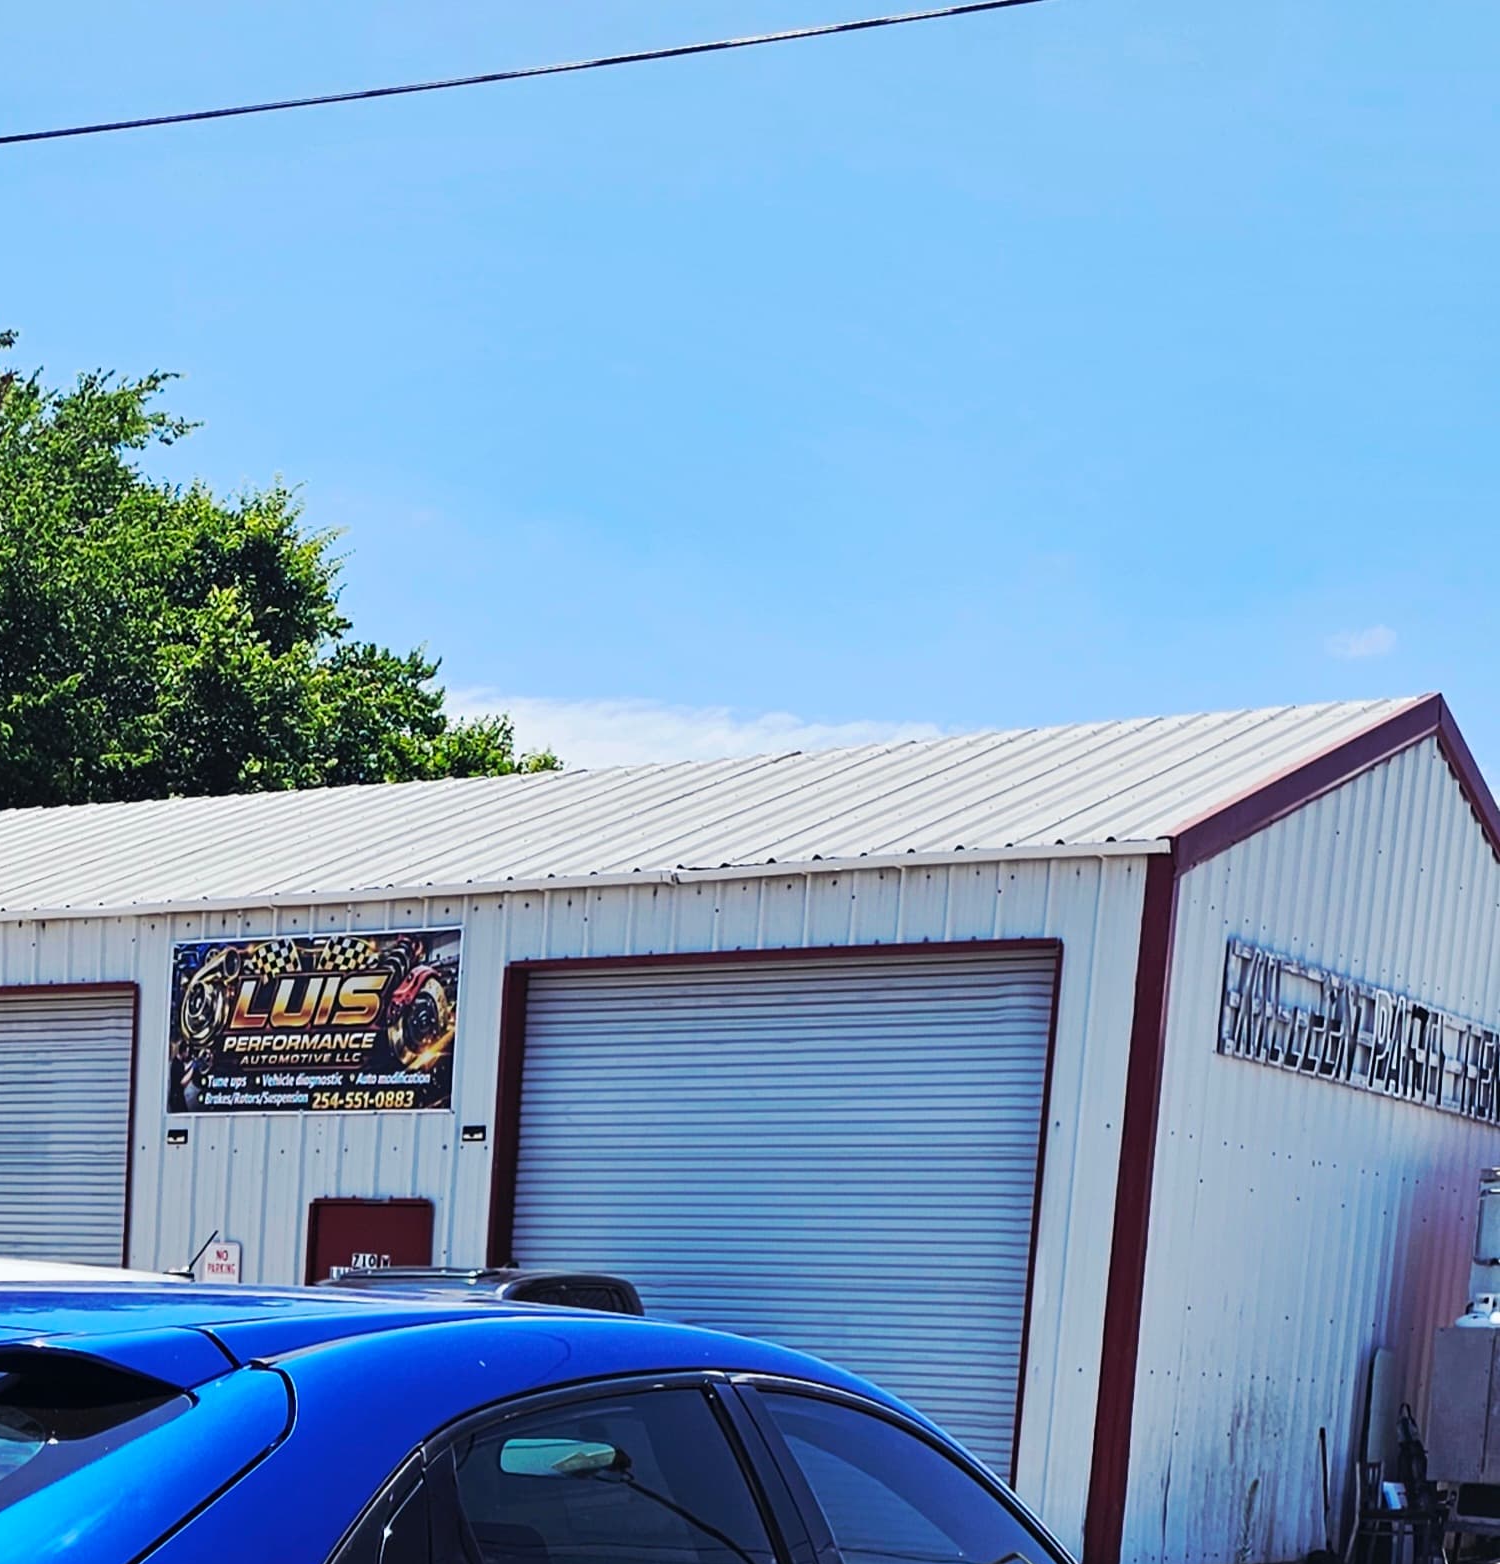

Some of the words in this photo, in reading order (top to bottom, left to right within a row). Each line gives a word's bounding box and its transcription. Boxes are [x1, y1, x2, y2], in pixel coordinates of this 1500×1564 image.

[230, 974, 389, 1029] LUIS
[224, 1032, 376, 1052] PERFORMANCE
[240, 1054, 331, 1065] AUTOMOTIVE
[335, 1053, 361, 1063] LLC
[207, 1074, 229, 1088] Tune
[230, 1076, 247, 1089] ups
[262, 1073, 294, 1087] Vehicle
[295, 1072, 343, 1088] diagnostic
[355, 1072, 377, 1085] Auto
[378, 1070, 431, 1085] modification
[204, 1091, 309, 1107] Brakes/Rotors/Suspension
[311, 1090, 414, 1109] 254-551-0883
[216, 1250, 228, 1261] NO
[208, 1263, 235, 1274] PARKING
